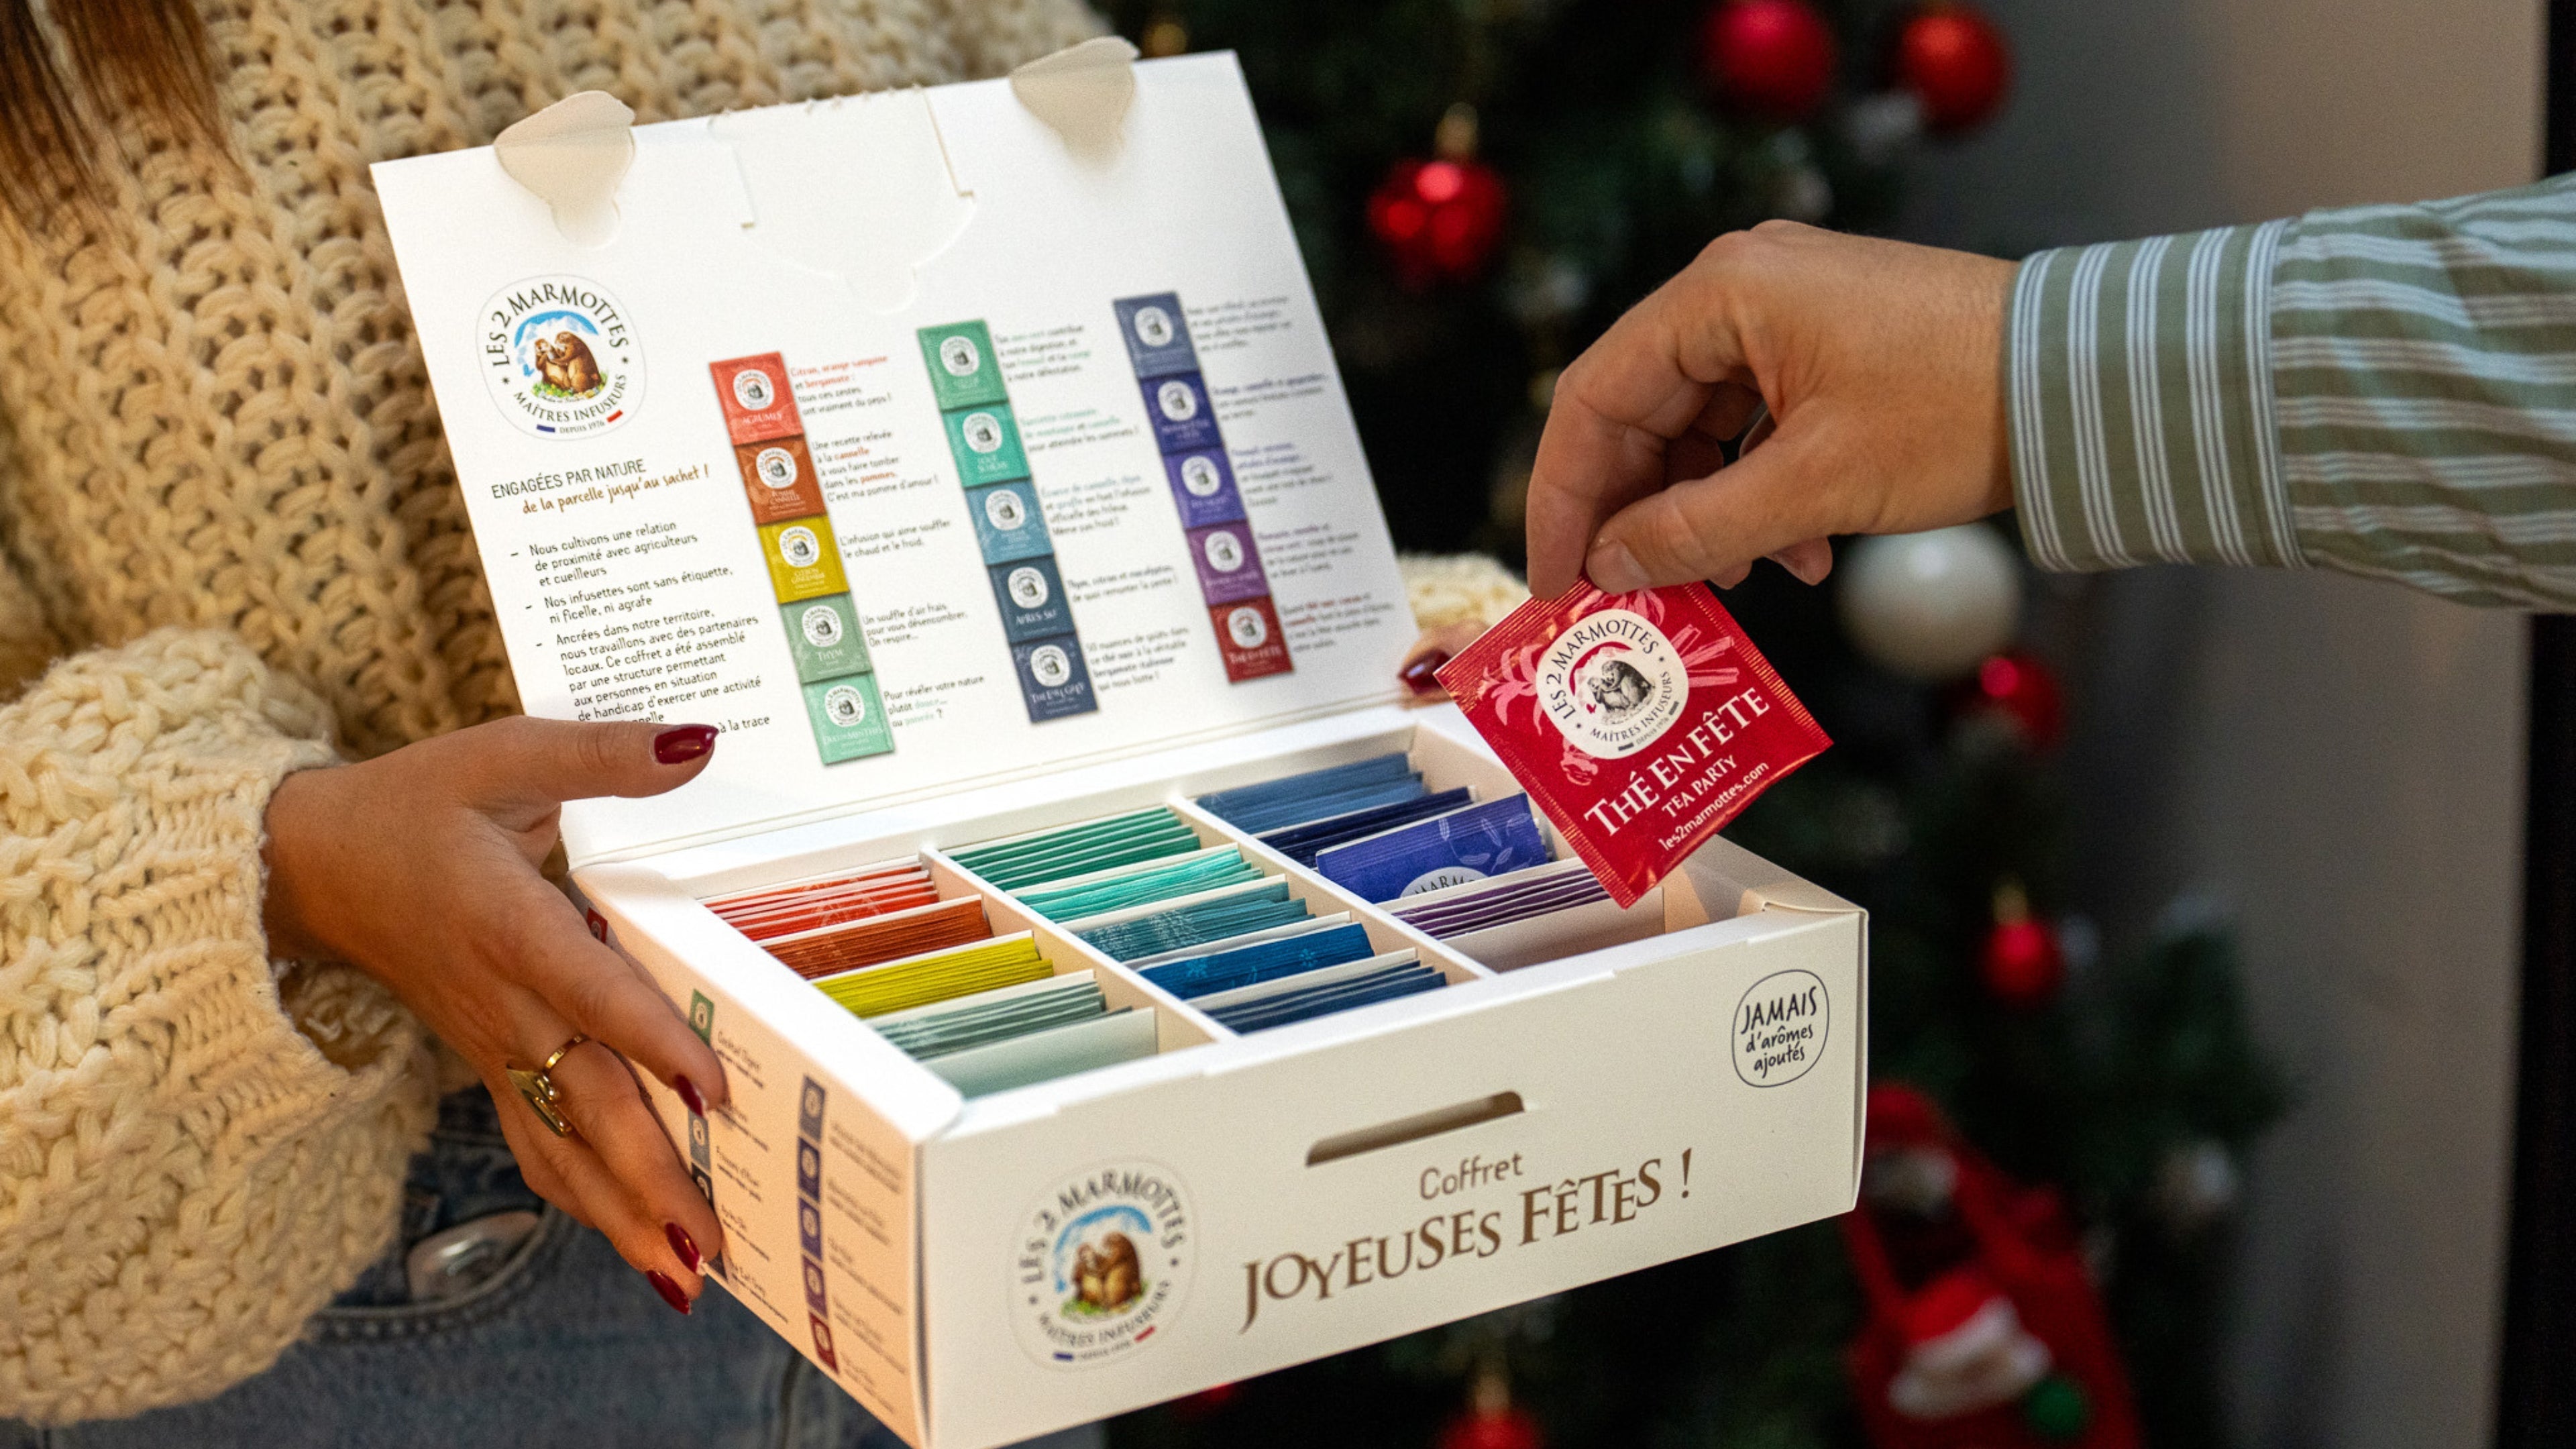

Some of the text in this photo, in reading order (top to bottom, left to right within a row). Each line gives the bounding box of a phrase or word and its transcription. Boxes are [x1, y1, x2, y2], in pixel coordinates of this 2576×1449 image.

[487, 282, 629, 368] LES 2 MARMOTTES
[513, 373, 627, 422] MAÎTRES INFUSEURS
[559, 425, 586, 434] DEPUIS
[491, 459, 646, 498] ENGAGÉES PAR NATURE
[523, 464, 708, 514] de la parcelle jusqu'au sachet !
[529, 523, 676, 556] Nous cultivons une relation
[535, 535, 698, 572] de proximité avec agriculteurs
[539, 568, 607, 586] et cueilleurs
[544, 568, 733, 608] Nos infusettes sont sans étiquette,
[549, 595, 652, 623] ni ficelle, ni agrafe
[557, 609, 714, 645] Ancrées dans notre territoire,
[560, 616, 759, 661] nous travaillons avec des partenaires
[563, 633, 745, 676] locaux. Ce coffret a été assemblé
[569, 653, 726, 693] par une structure permettant
[574, 672, 717, 707] aux personnes en situation
[884, 691, 902, 700] Pour
[958, 676, 983, 686] nature
[1547, 619, 1660, 719] LES 2 MARMOTTES
[578, 676, 761, 722] de handicap d'exercer une activité
[1591, 671, 1673, 743] MAÎTRES INFUSEURS
[729, 720, 739, 731] la
[743, 716, 770, 729] trace
[1584, 688, 1770, 836] THÉ EN FÊTE
[1658, 761, 1770, 851] les2marmottes.com
[1662, 755, 1738, 818] TEA PARTY
[1741, 986, 1817, 1034] JAMAIS
[1746, 1024, 1813, 1053] d'arômes
[1754, 1041, 1805, 1079] ajoutés
[1419, 1152, 1523, 1201] Coffret
[1059, 1169, 1186, 1249] MARMOTTES
[1239, 1148, 1692, 1334] JOYEUSES FÊTES !
